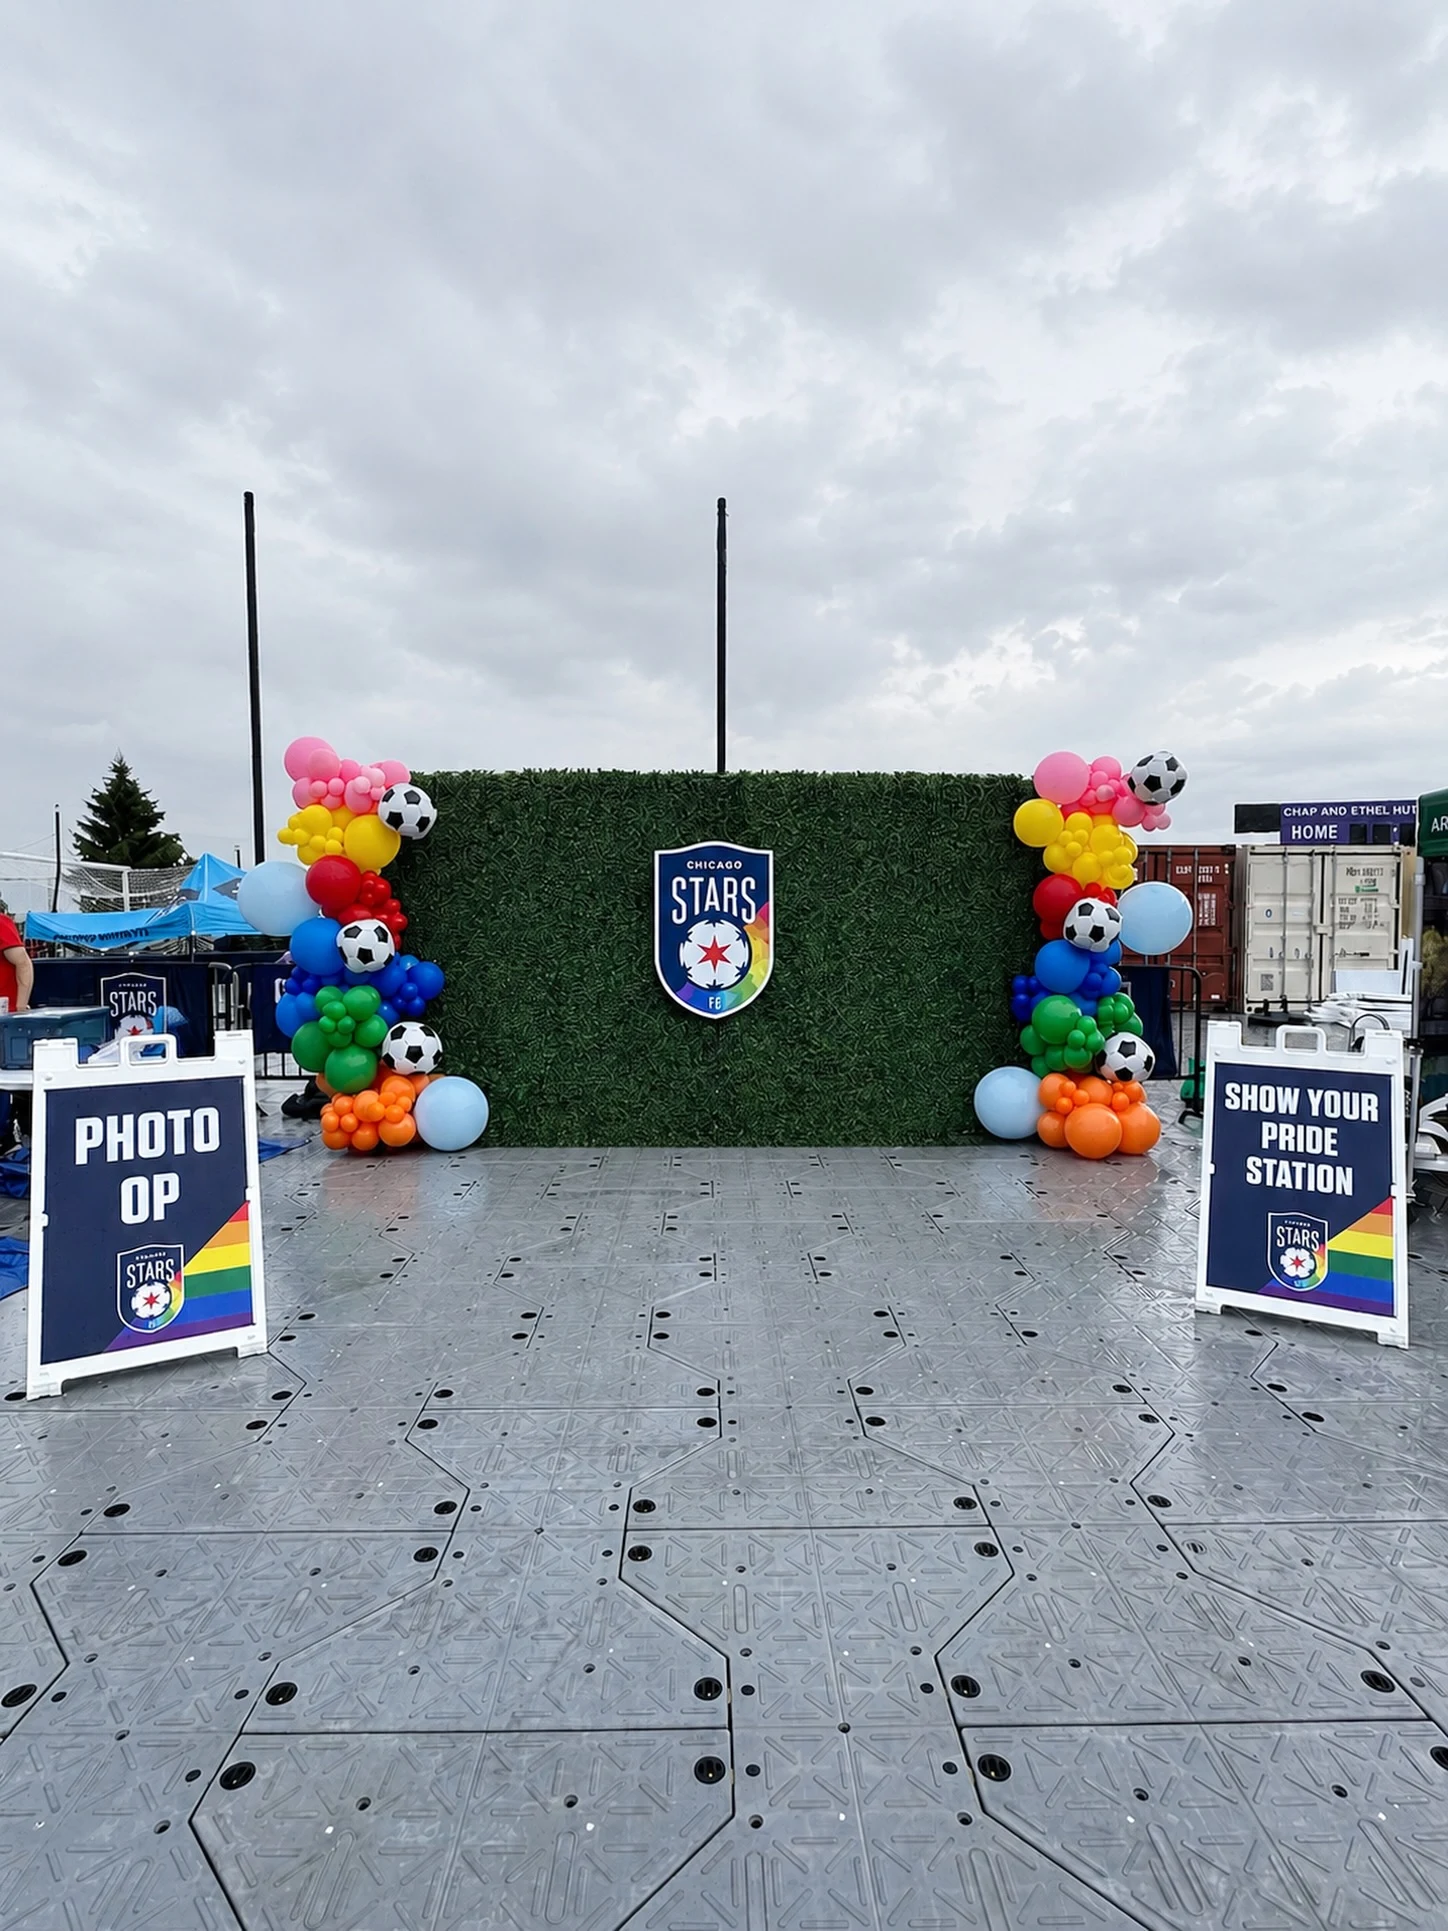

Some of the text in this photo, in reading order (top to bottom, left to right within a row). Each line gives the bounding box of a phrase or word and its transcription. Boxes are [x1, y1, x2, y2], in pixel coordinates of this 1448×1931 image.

[1283, 807, 1318, 817] CHAP
[1351, 804, 1390, 816] ETHEL
[1291, 824, 1338, 840] HOME
[686, 860, 743, 870] CHICAGO
[671, 876, 756, 925] STARS
[109, 991, 157, 1018] STARS
[1224, 1082, 1380, 1123] SHOW YOUR
[74, 1106, 221, 1166] PHOTO
[1261, 1121, 1339, 1157] PRIDE
[1246, 1155, 1354, 1197] STATION
[120, 1172, 181, 1225] OP
[1276, 1225, 1320, 1252] STARS
[126, 1258, 175, 1289] STARS
